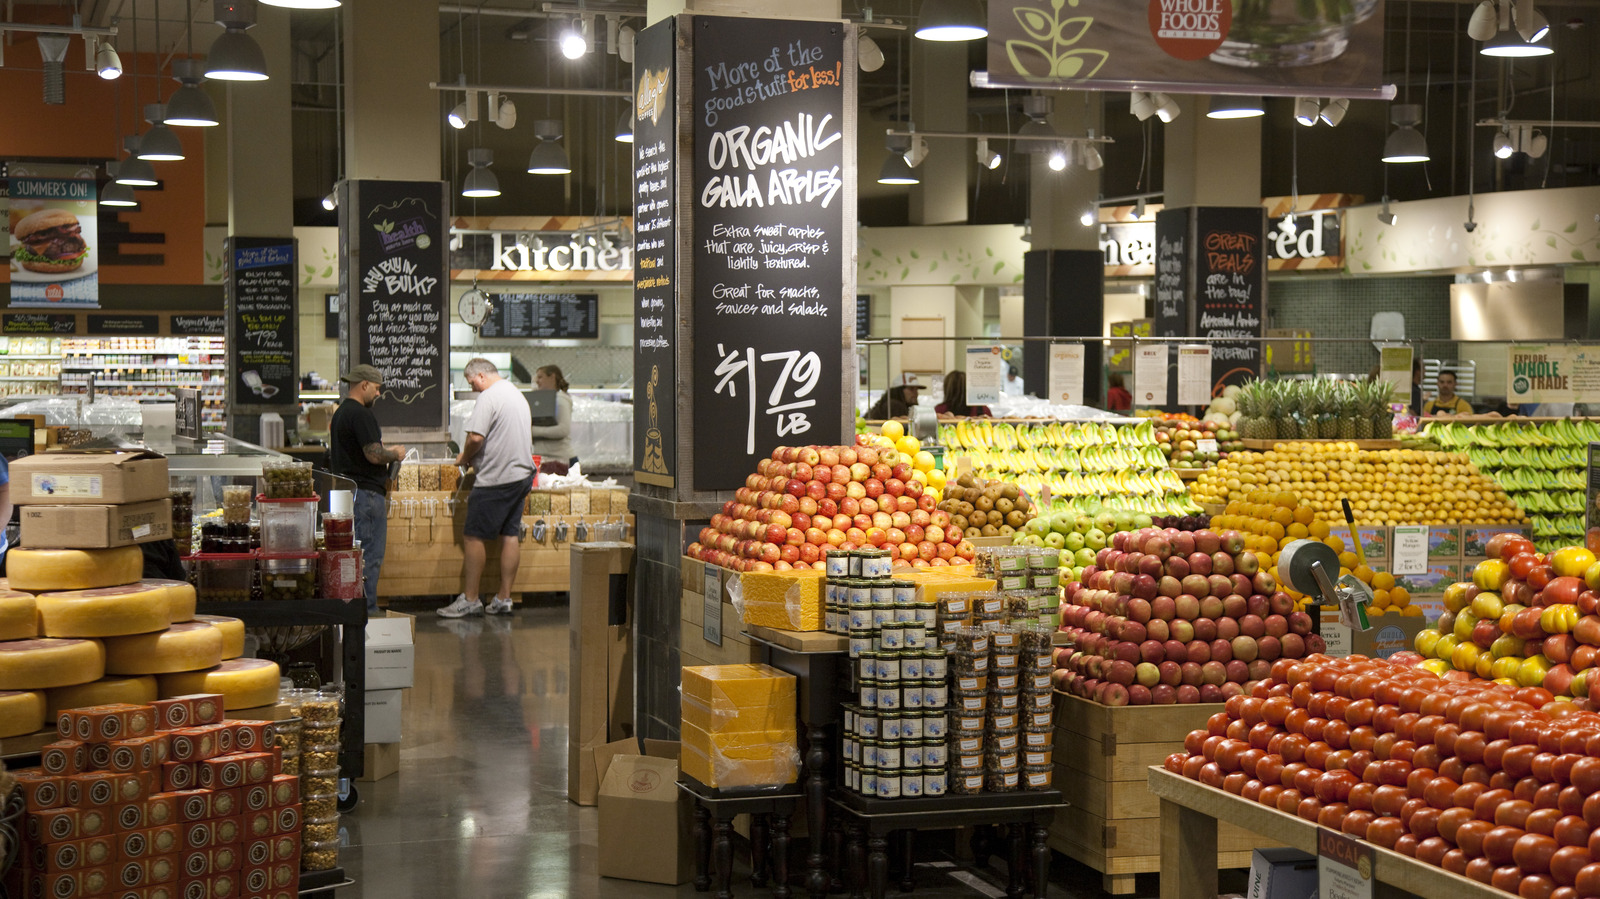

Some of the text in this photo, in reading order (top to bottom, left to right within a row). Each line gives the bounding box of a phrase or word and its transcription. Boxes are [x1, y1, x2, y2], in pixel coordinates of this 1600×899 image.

[1160, 0, 1222, 13] WHOLE
[1160, 12, 1219, 31] FOODS
[704, 39, 823, 93] More of the
[704, 61, 842, 127] good stuff for less!
[708, 112, 842, 171] ORGANIC
[17, 181, 67, 196] SUMMER'S
[69, 183, 88, 197] ON!
[701, 165, 842, 209] GALA APPLES
[712, 223, 825, 239] Extra sweet apples
[704, 240, 731, 254] that
[733, 241, 755, 254] are
[822, 240, 829, 256] &
[1205, 233, 1255, 252] GREAT
[727, 255, 810, 270] lightly textured.
[1207, 252, 1254, 273] DEALS
[363, 257, 417, 293] WHY BUY IN
[1206, 272, 1245, 285] are in
[385, 274, 437, 296] BULK?
[712, 283, 820, 299] Great for snacks,
[1204, 285, 1227, 299] the
[373, 299, 432, 313] Buy as much or
[715, 300, 828, 317] sauces and salads.
[368, 311, 439, 322] as little as you need
[368, 321, 437, 334] and since there is
[369, 334, 385, 345] less
[368, 343, 390, 356] there
[391, 345, 399, 355] is
[400, 344, 415, 356] less
[1211, 347, 1259, 360] RAPEFRUIT
[372, 355, 431, 366] lower cost and a
[1514, 354, 1547, 363] EXPLORE
[375, 365, 433, 377] maller carbon
[1513, 361, 1559, 377] WHOLE
[382, 377, 421, 389] footprint.
[1529, 376, 1569, 390] TRADE
[776, 412, 811, 437] LB
[1320, 833, 1359, 864] LOCAL
